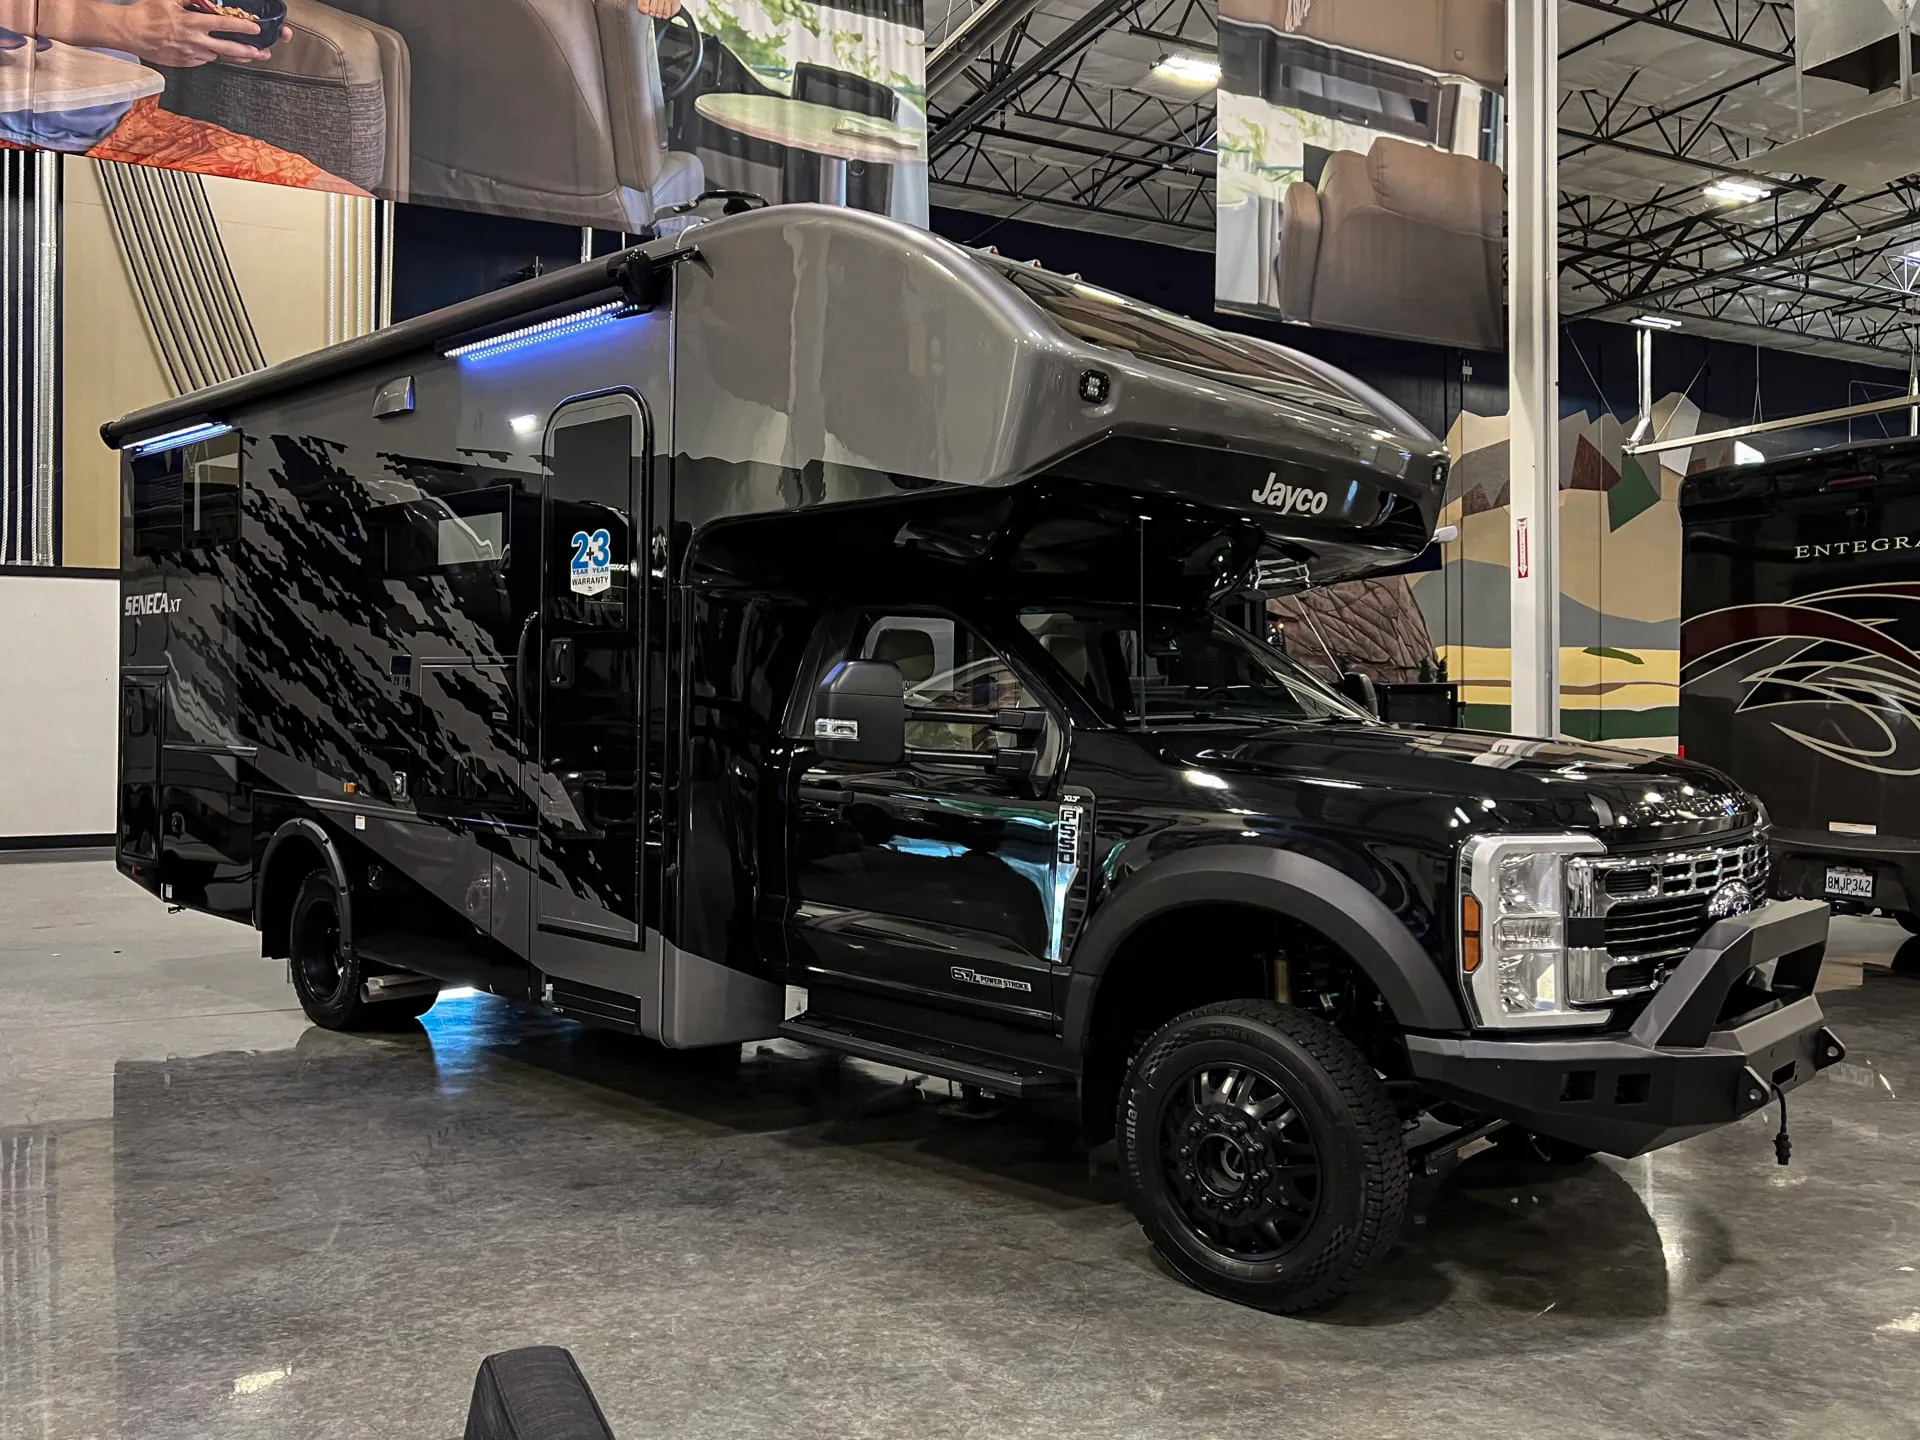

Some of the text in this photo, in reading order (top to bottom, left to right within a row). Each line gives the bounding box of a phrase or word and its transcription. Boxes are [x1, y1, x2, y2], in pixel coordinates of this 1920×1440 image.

[1252, 472, 1328, 515] Jayco
[592, 566, 609, 574] YEAR
[572, 576, 609, 586] WARRANTY
[124, 592, 182, 616] SENECA XT
[1063, 794, 1081, 803] XLT
[1058, 809, 1077, 864] F550
[1827, 876, 1871, 893] 8MJP342
[951, 967, 1030, 991] 6.7L POWER STROKE
